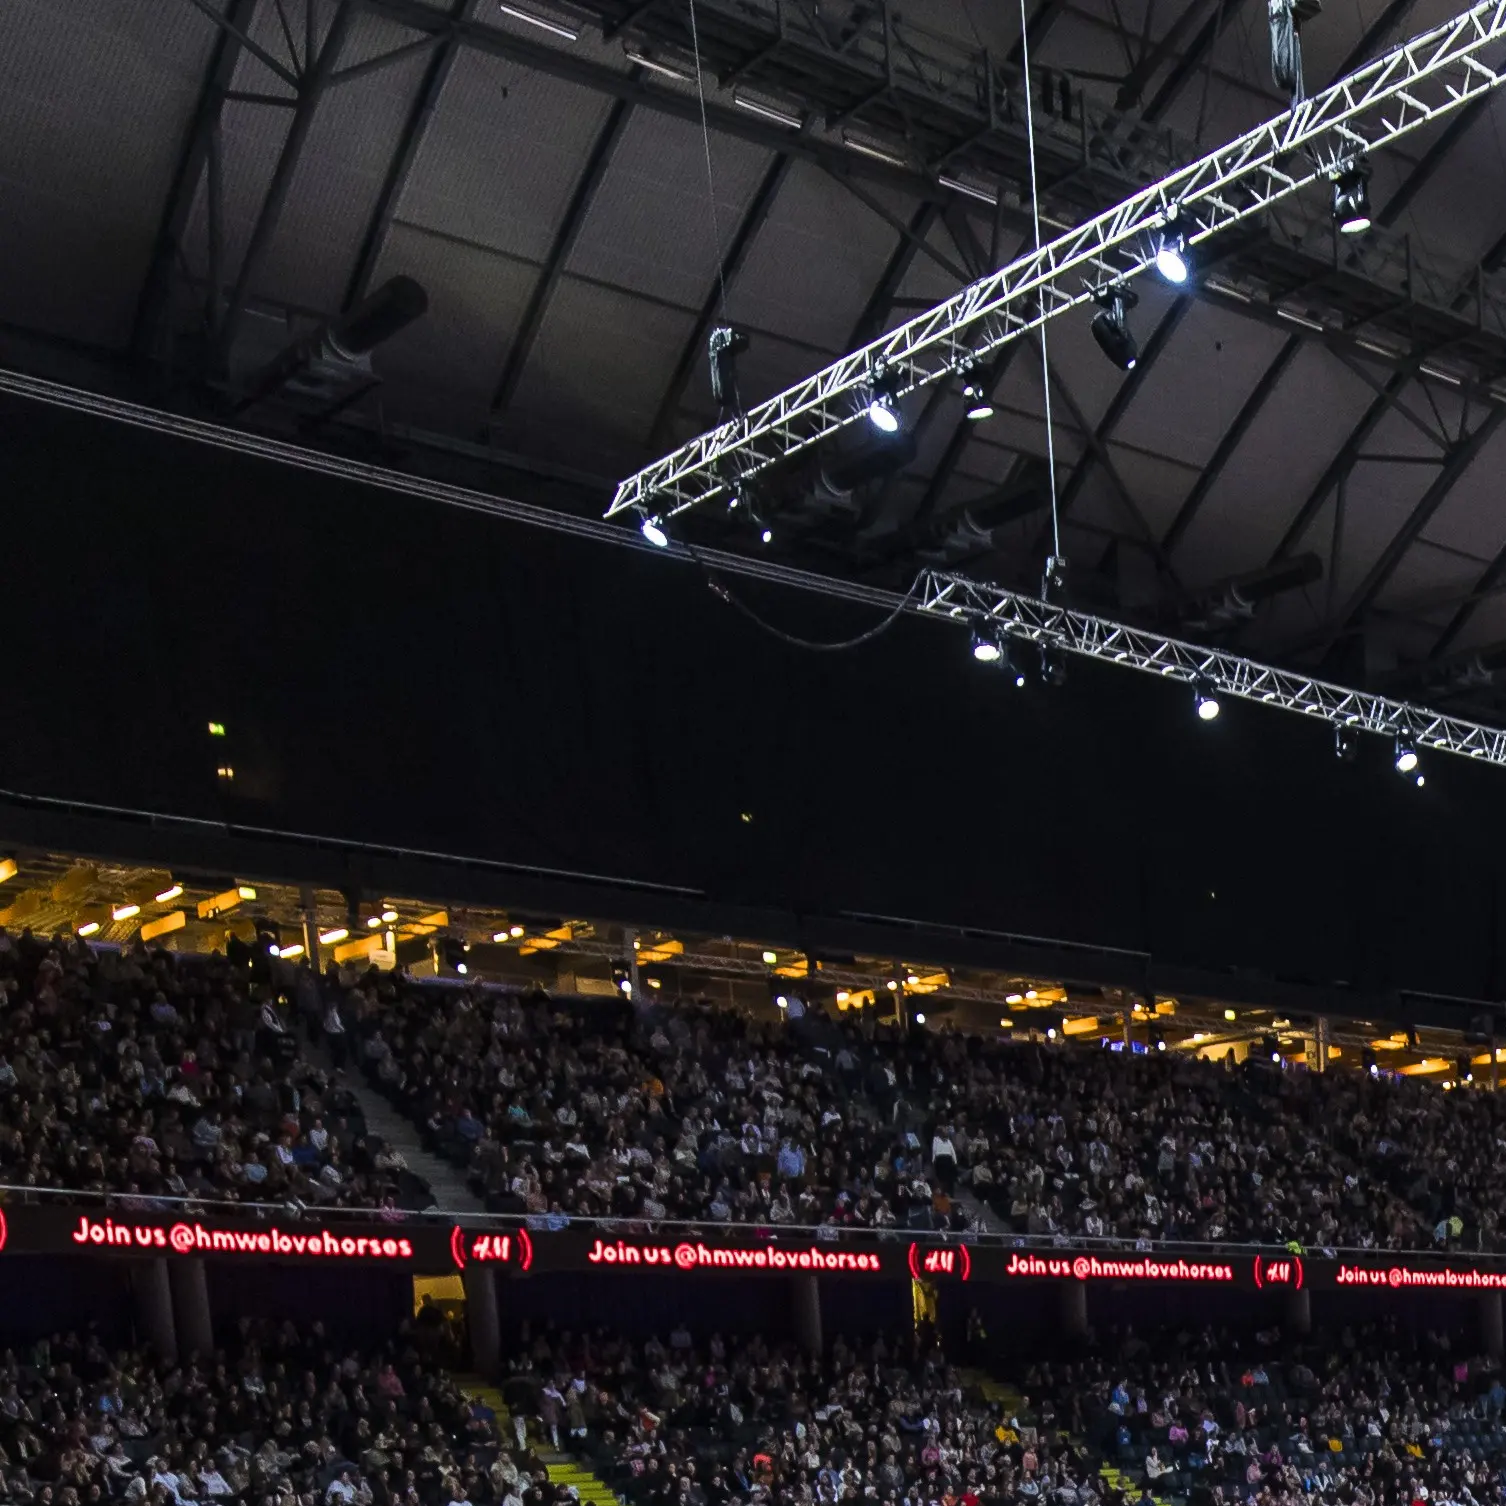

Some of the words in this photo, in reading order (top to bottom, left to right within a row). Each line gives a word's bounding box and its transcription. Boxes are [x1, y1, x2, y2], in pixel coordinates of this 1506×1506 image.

[72, 1216, 133, 1246] Join
[134, 1225, 167, 1247] us
[588, 1239, 641, 1264] Join
[642, 1246, 673, 1265] us
[1006, 1253, 1048, 1275] Join
[1047, 1259, 1072, 1276] us
[1336, 1265, 1369, 1285] Join
[1369, 1270, 1389, 1285] us
